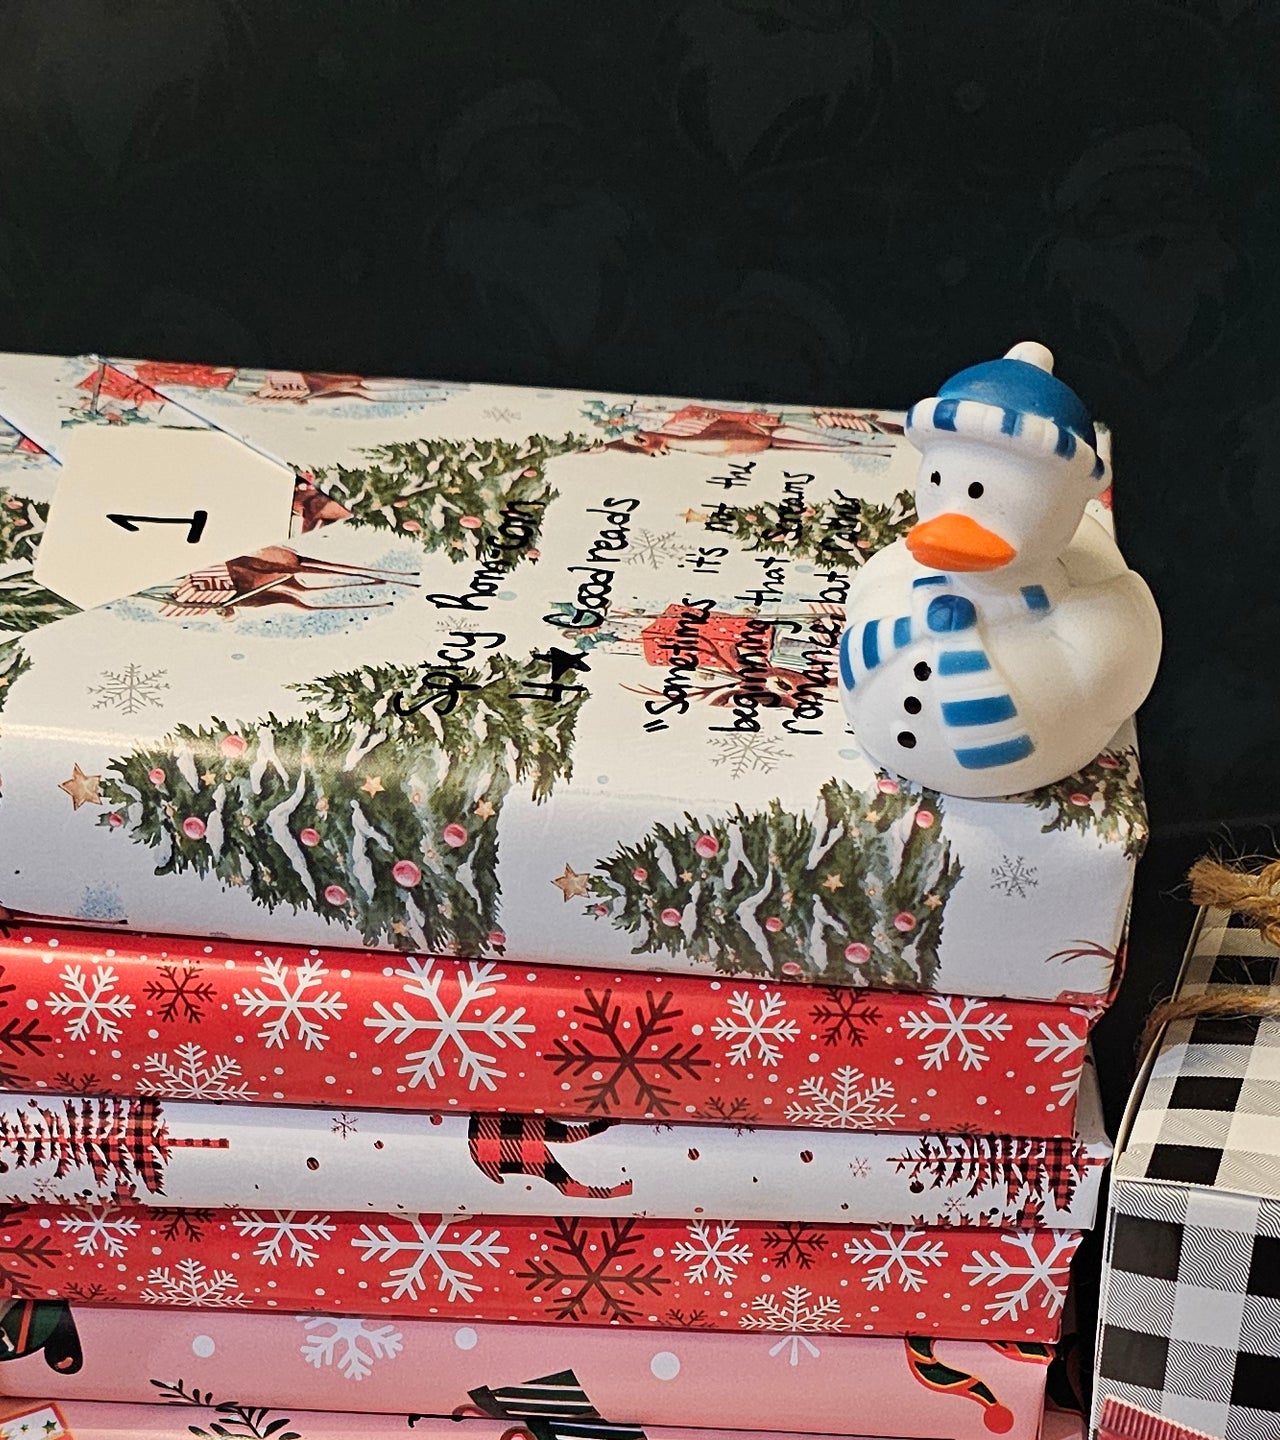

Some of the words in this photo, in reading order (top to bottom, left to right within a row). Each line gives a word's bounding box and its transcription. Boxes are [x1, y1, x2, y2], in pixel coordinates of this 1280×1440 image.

[705, 461, 756, 489] the
[105, 510, 208, 543] 1
[701, 502, 736, 533] not
[677, 547, 729, 573] it's
[734, 556, 791, 606] that
[799, 573, 850, 604] but
[393, 630, 506, 717] Spicy
[708, 620, 803, 733] beginning
